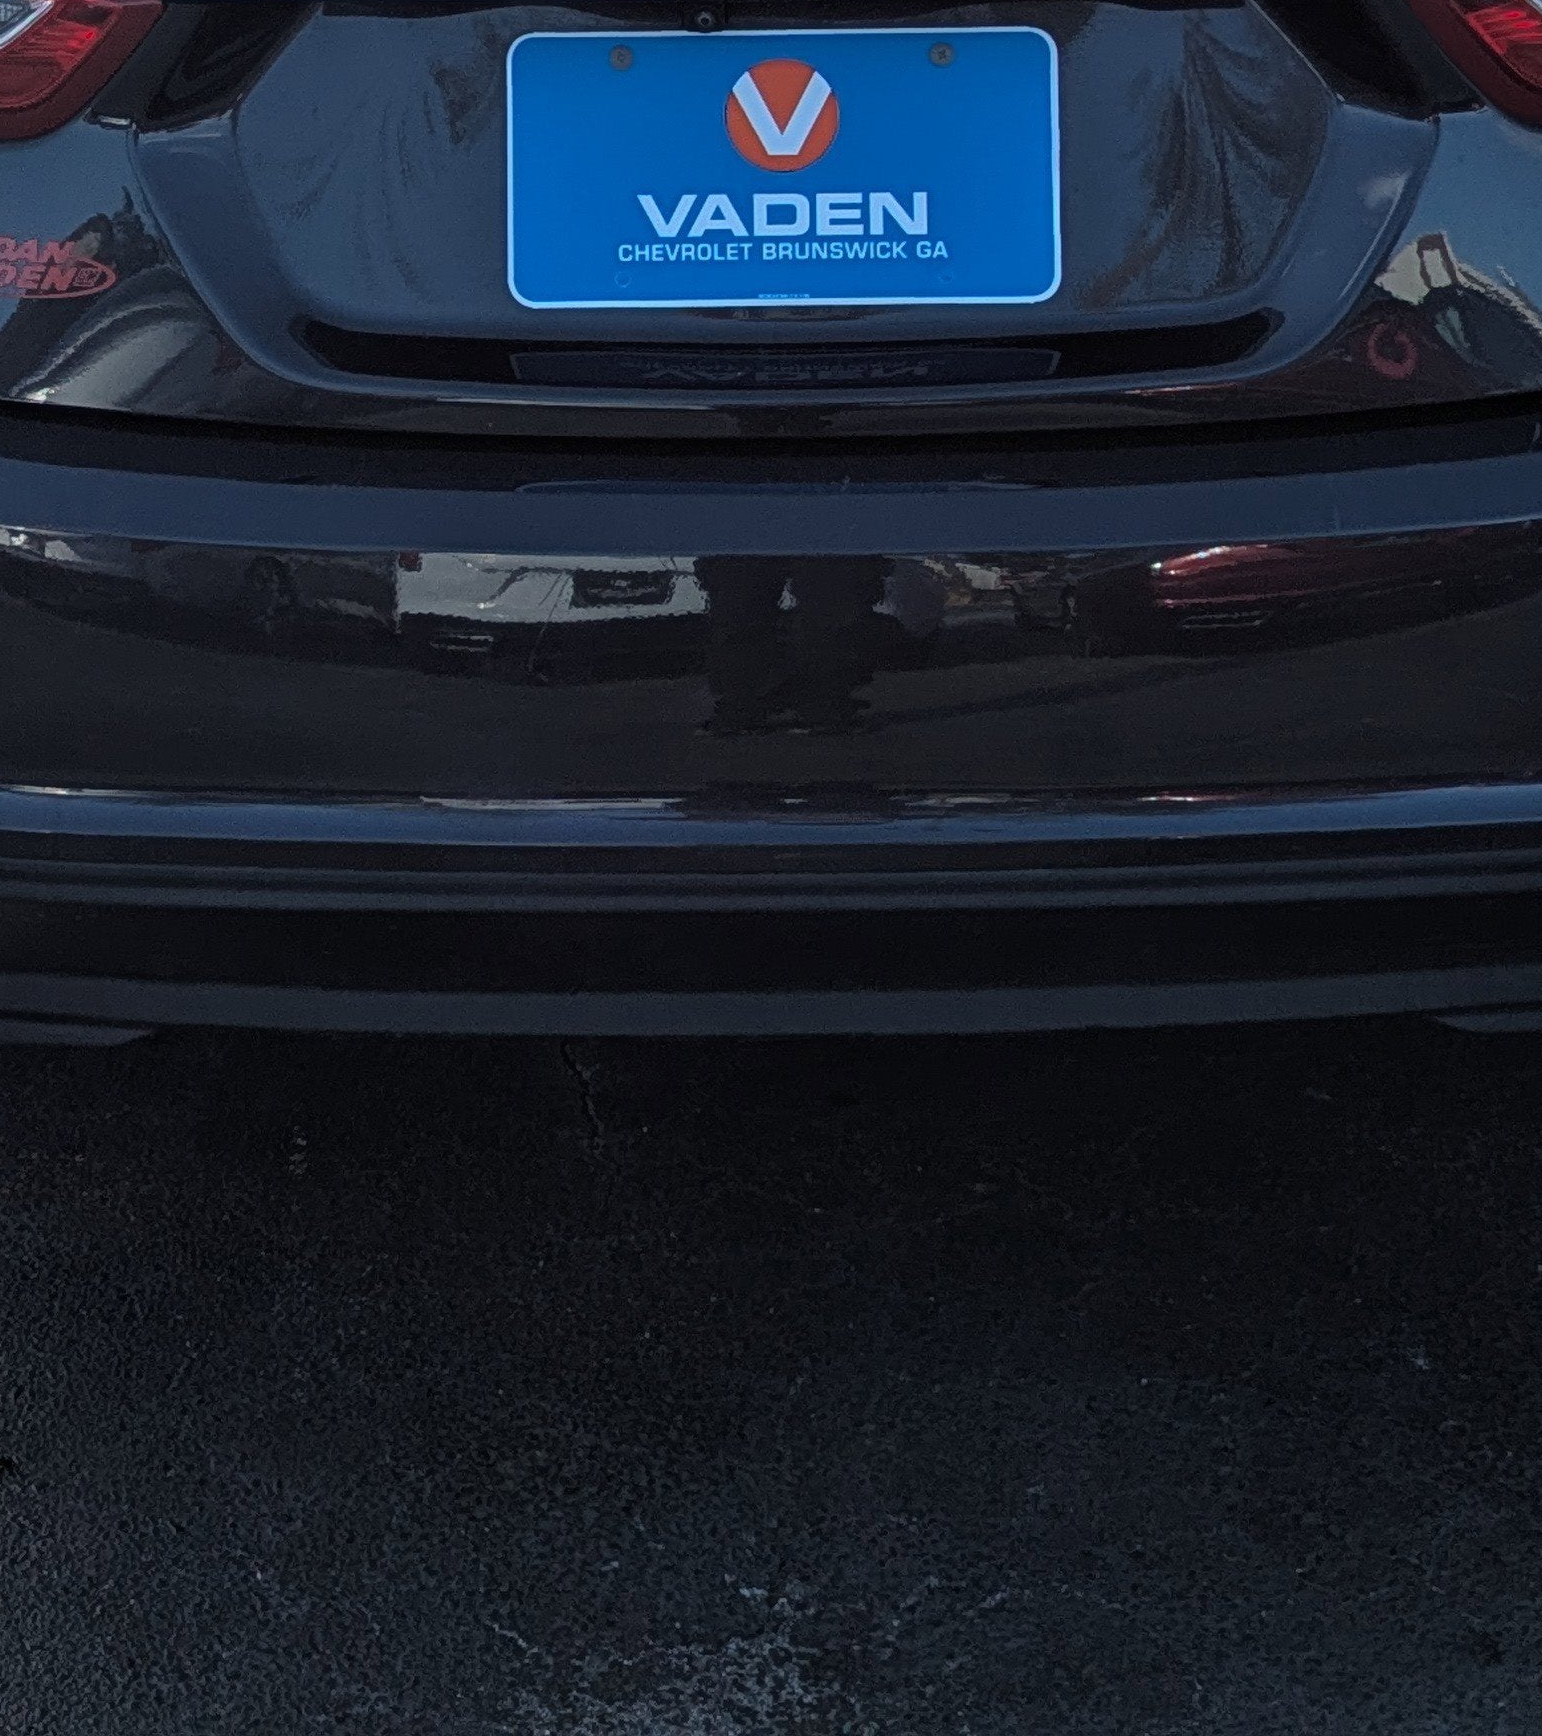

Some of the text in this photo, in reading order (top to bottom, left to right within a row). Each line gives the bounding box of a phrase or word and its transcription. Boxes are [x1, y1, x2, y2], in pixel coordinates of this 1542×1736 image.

[637, 191, 929, 237] VADEN
[618, 240, 949, 262] CHEVROLET BRUNSWICK GA
